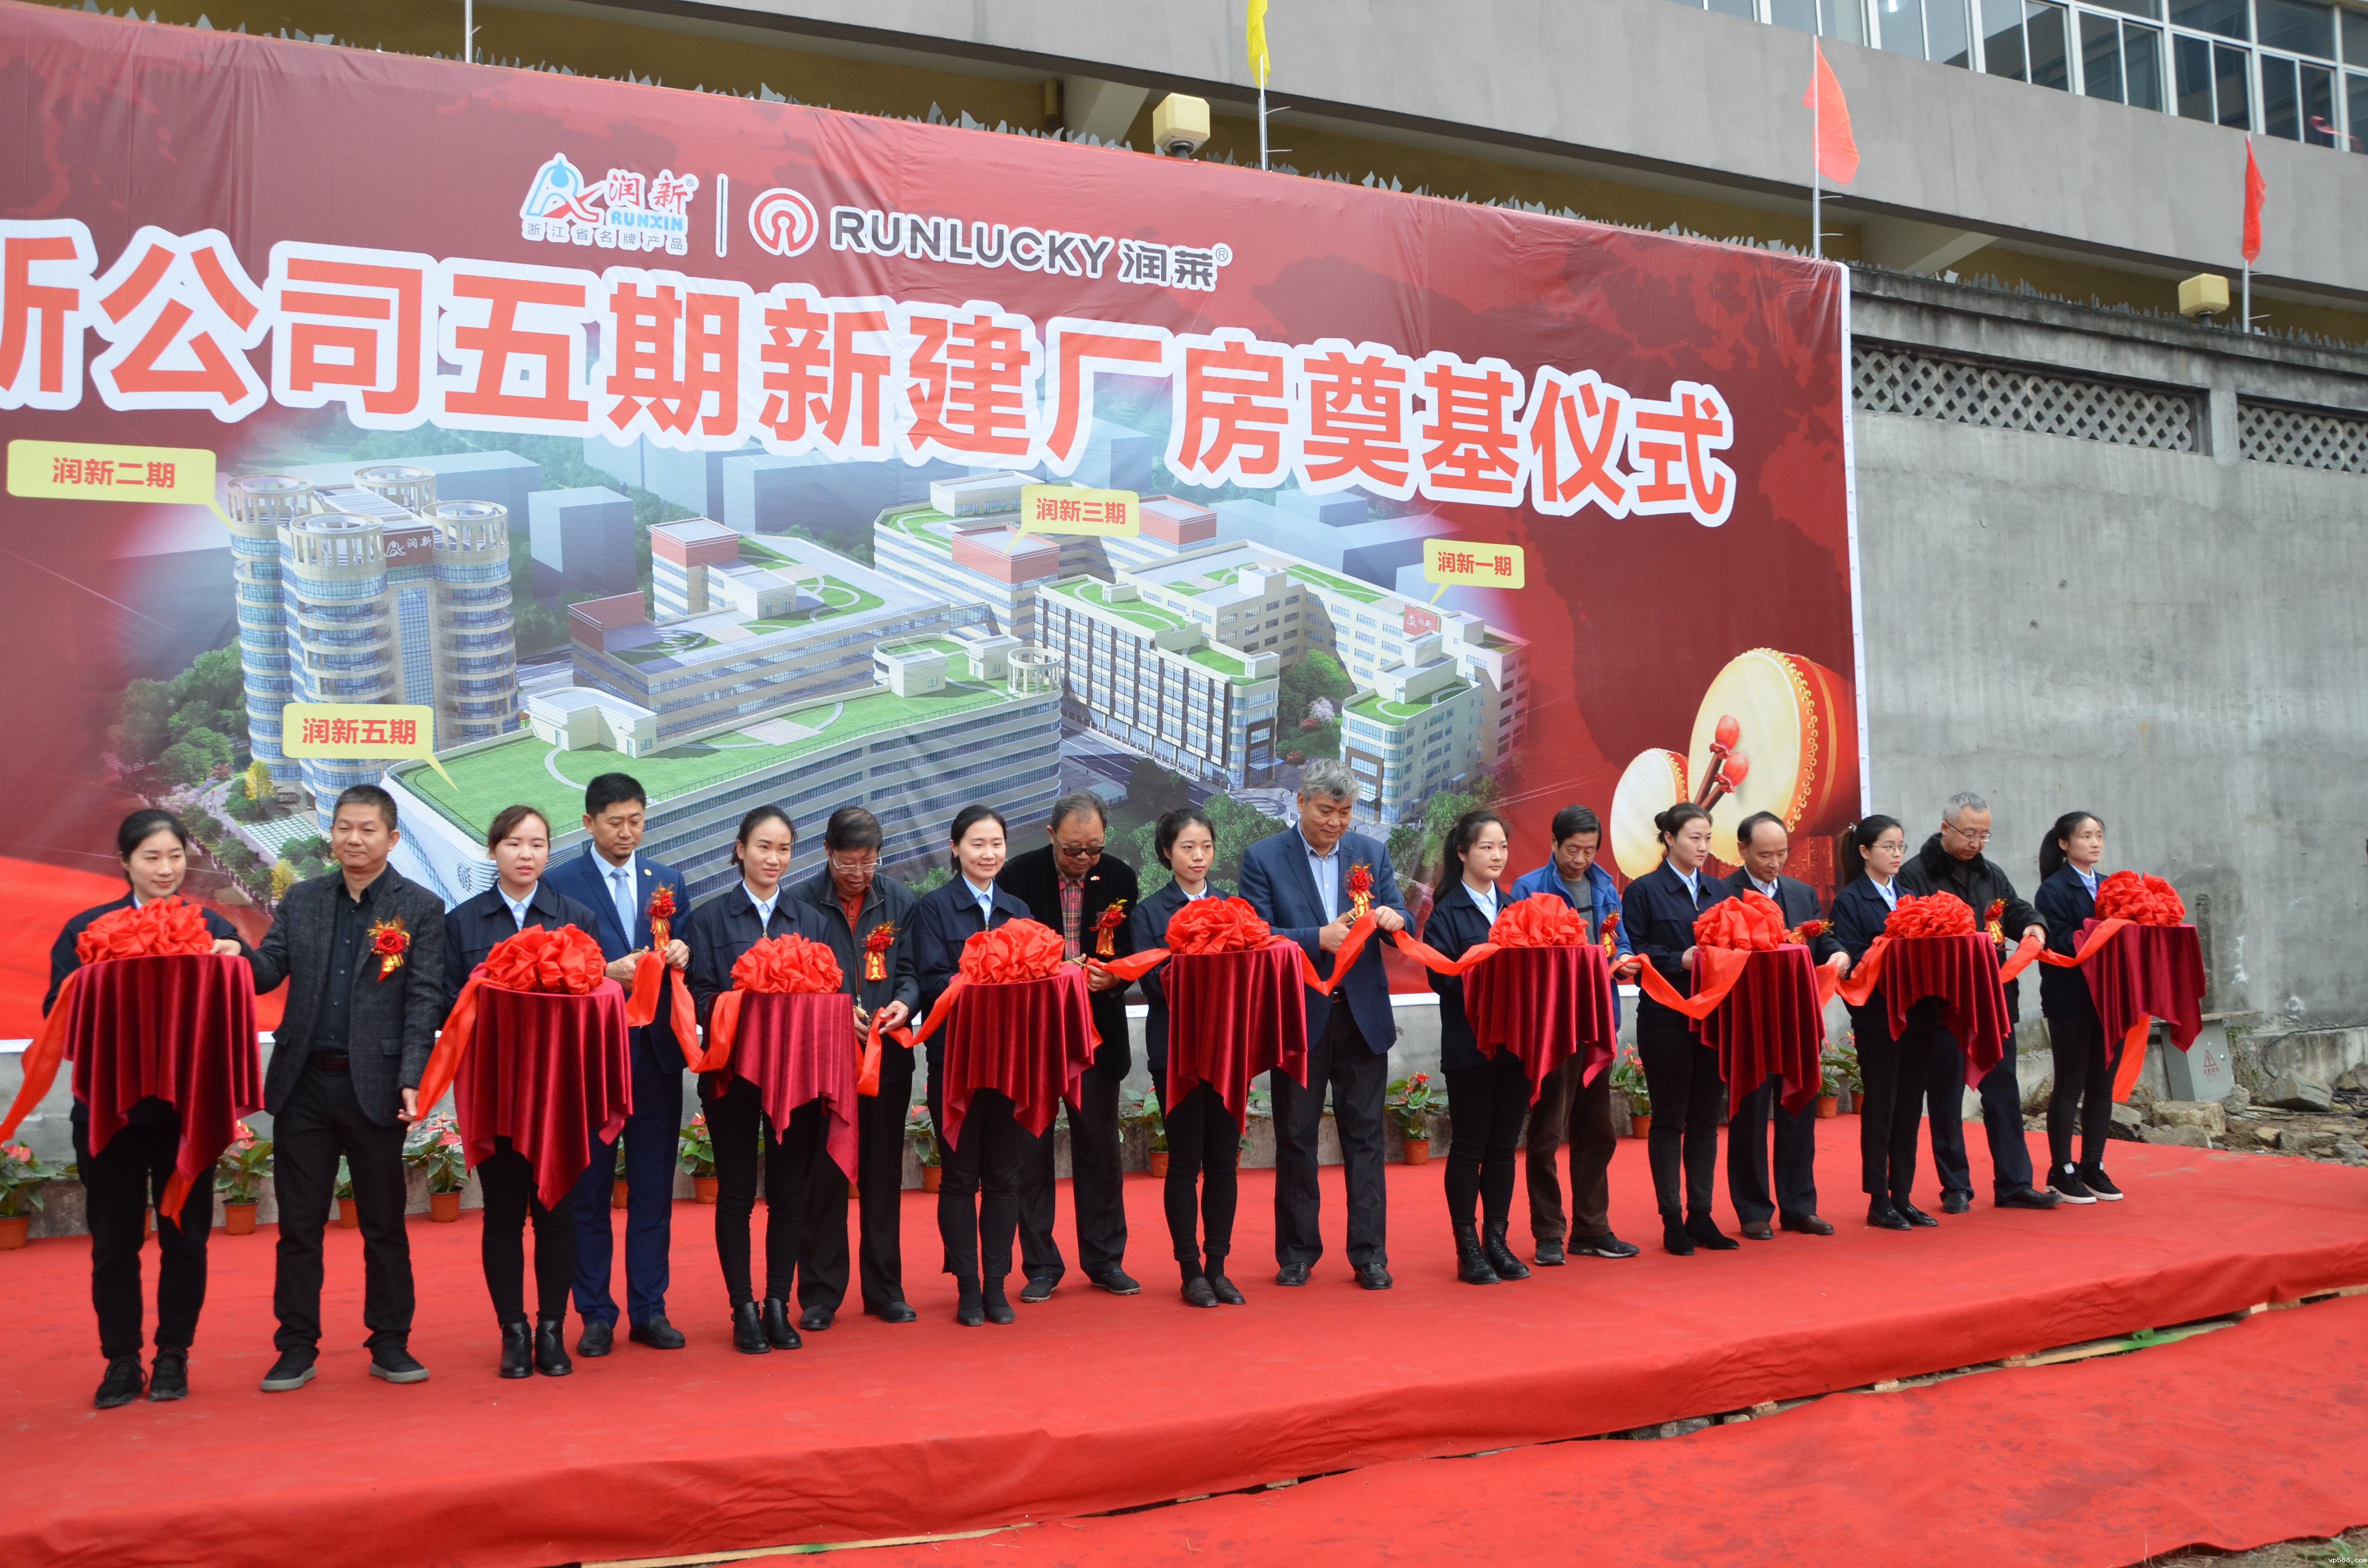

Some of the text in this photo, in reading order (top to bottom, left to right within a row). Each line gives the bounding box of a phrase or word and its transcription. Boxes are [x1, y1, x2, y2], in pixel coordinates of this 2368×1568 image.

[611, 211, 683, 231] RUNXIN
[527, 223, 682, 250] 浙江省名牌产品
[835, 211, 1110, 274] RUNLUCKY
[52, 457, 175, 488] 润新二期
[1036, 498, 1126, 525] 润新三期
[1438, 551, 1512, 576] 润新一期
[302, 718, 416, 745] 润新五期
